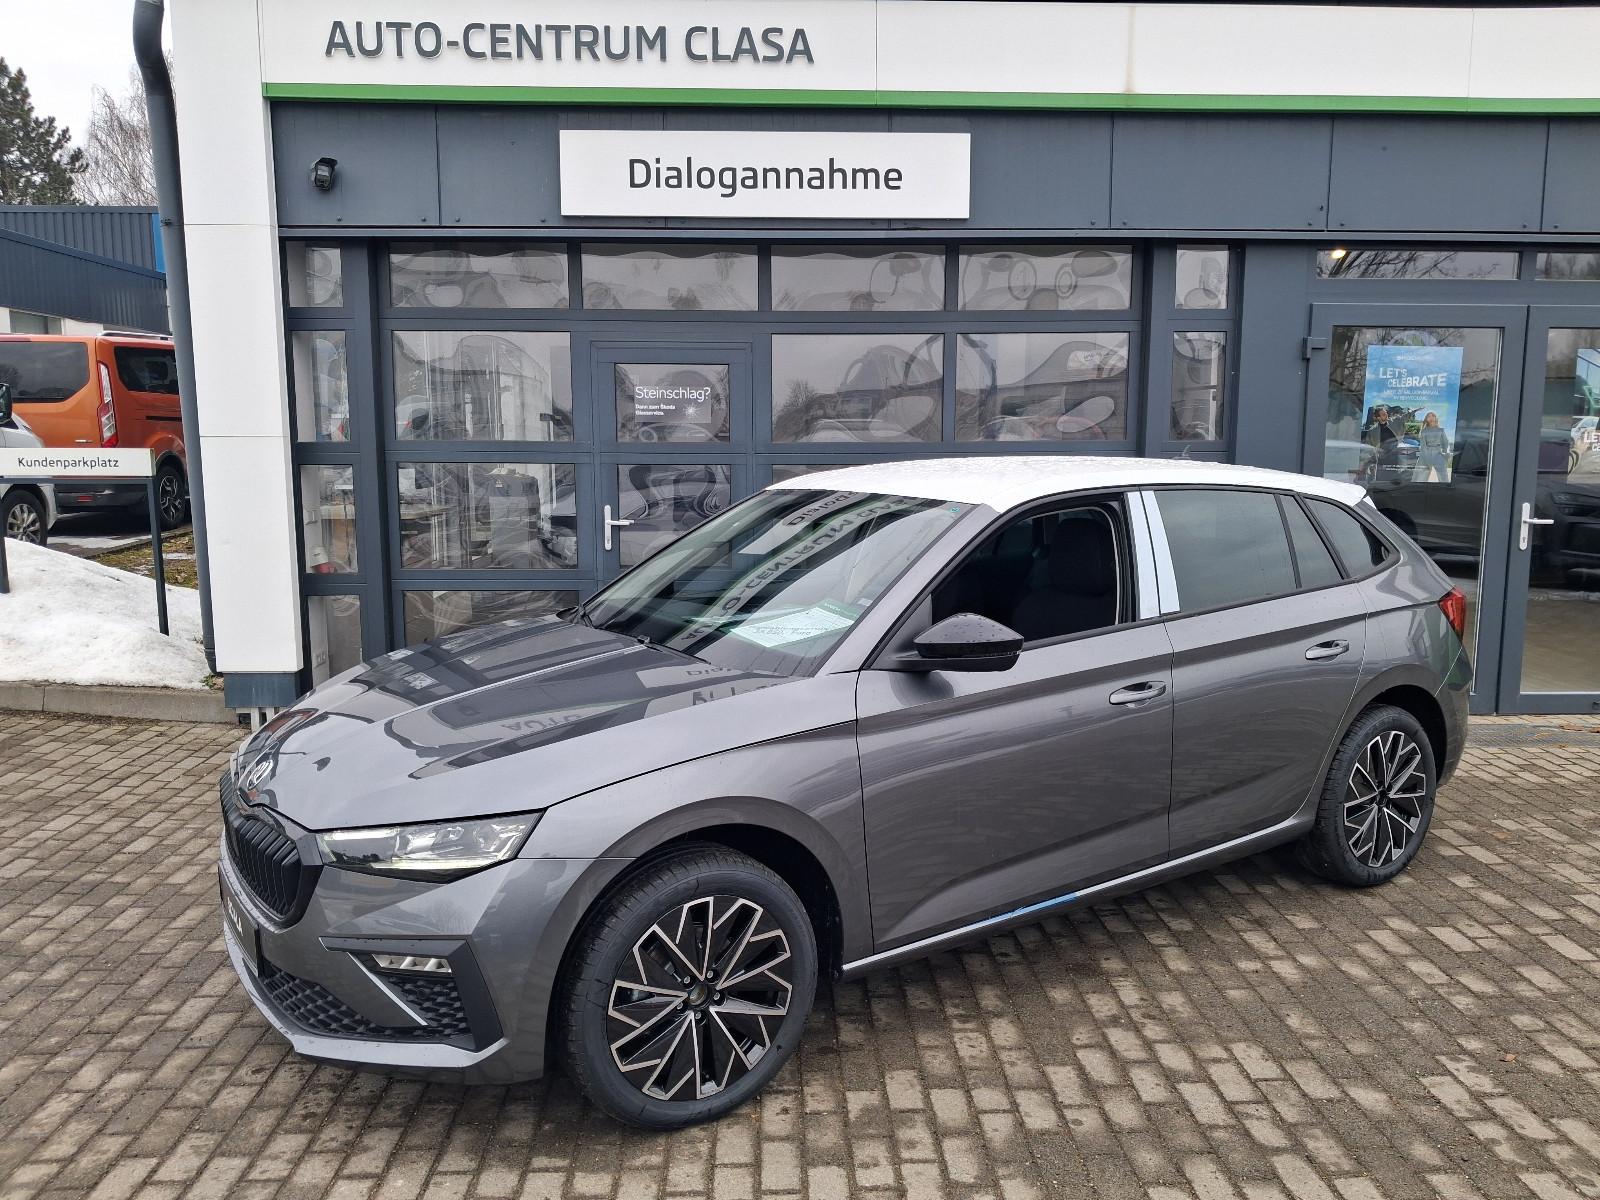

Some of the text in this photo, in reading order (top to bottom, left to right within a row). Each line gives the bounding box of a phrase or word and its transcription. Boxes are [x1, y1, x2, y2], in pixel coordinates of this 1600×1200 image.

[325, 20, 815, 64] AUTO-CENTRUM CLASA
[628, 157, 903, 198] Dialogannahme
[1380, 367, 1408, 379] LET'S
[1387, 372, 1448, 388] CELEBRATE
[635, 386, 711, 402] Steinschlag?
[17, 457, 120, 470] Kundenparkplatz
